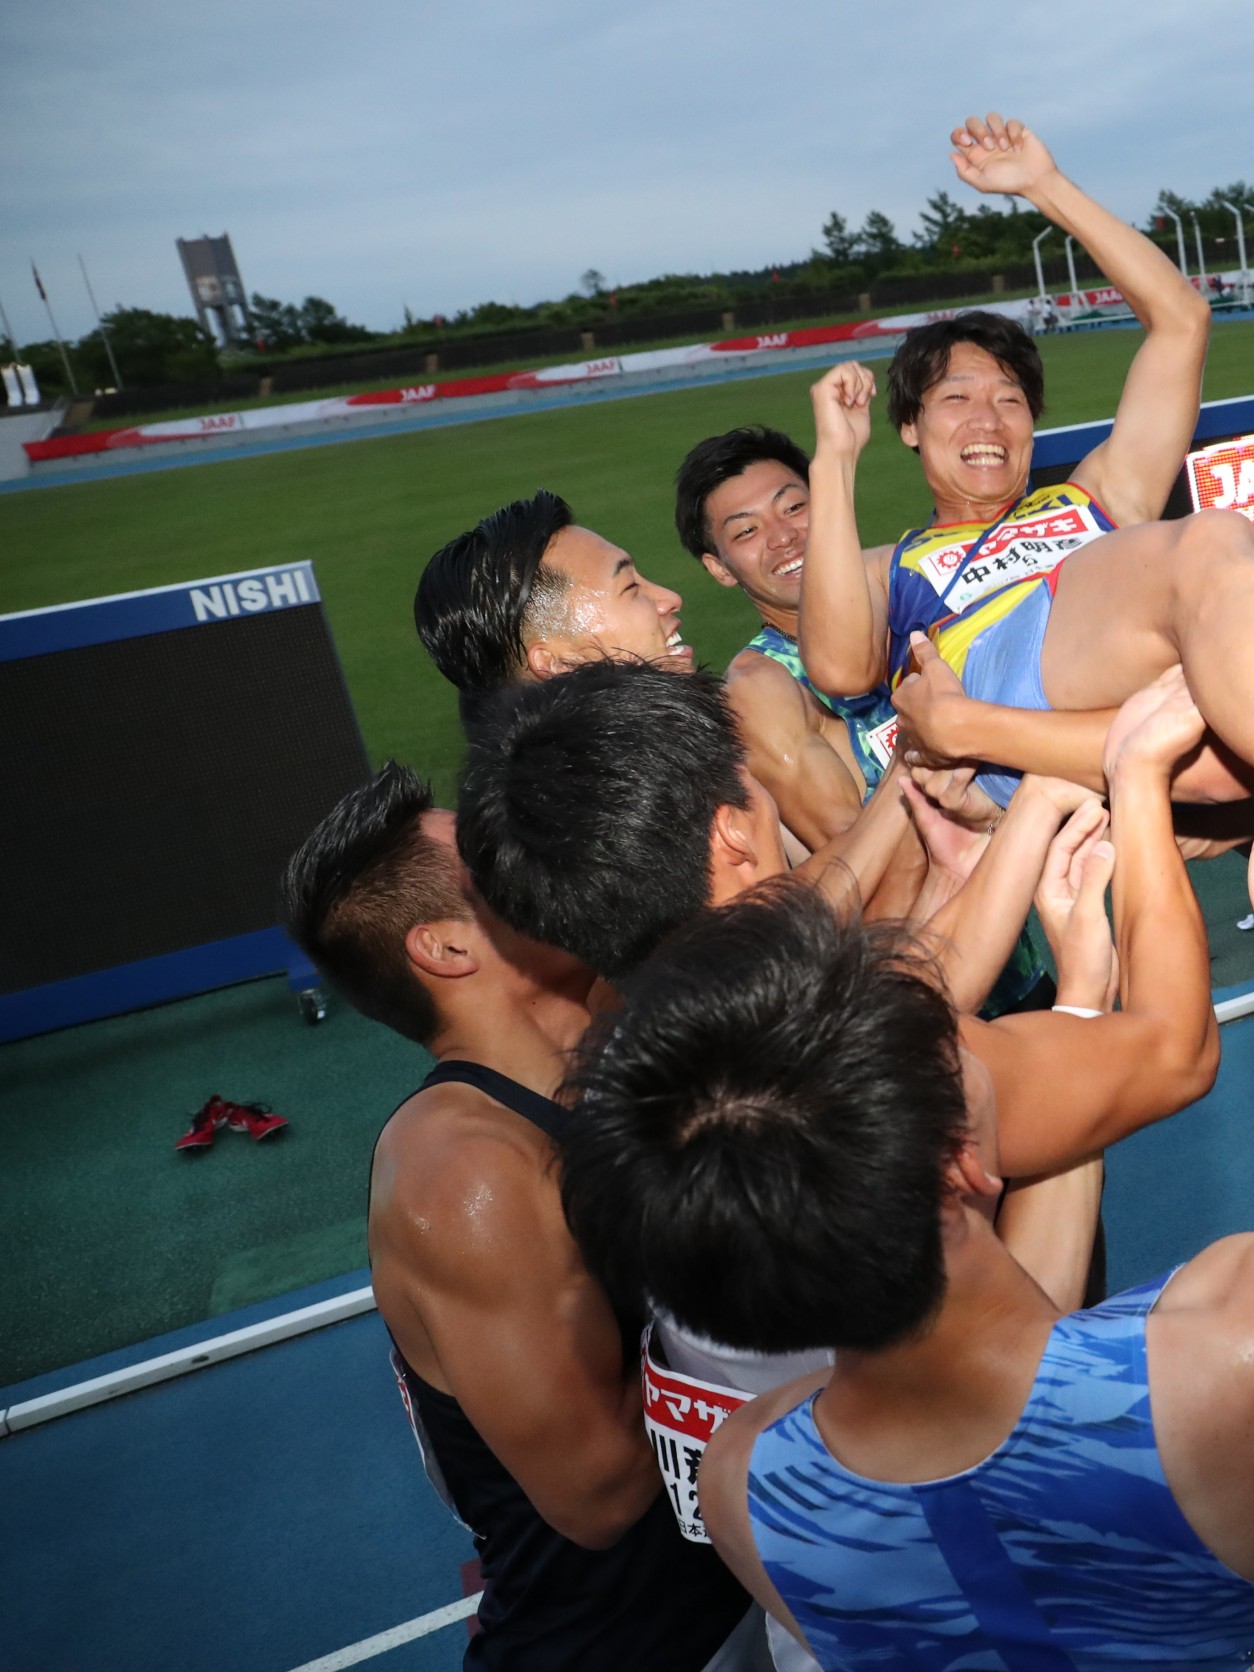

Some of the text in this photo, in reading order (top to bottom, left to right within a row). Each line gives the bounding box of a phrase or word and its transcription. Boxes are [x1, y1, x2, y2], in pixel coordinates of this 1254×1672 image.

[1096, 289, 1123, 304] JAA
[756, 333, 790, 348] JAAF
[585, 359, 618, 374] JAAF
[399, 384, 437, 402] JAAF
[199, 415, 237, 431] JAAF
[189, 569, 311, 622] NISHI
[678, 1517, 710, 1537] 日本
